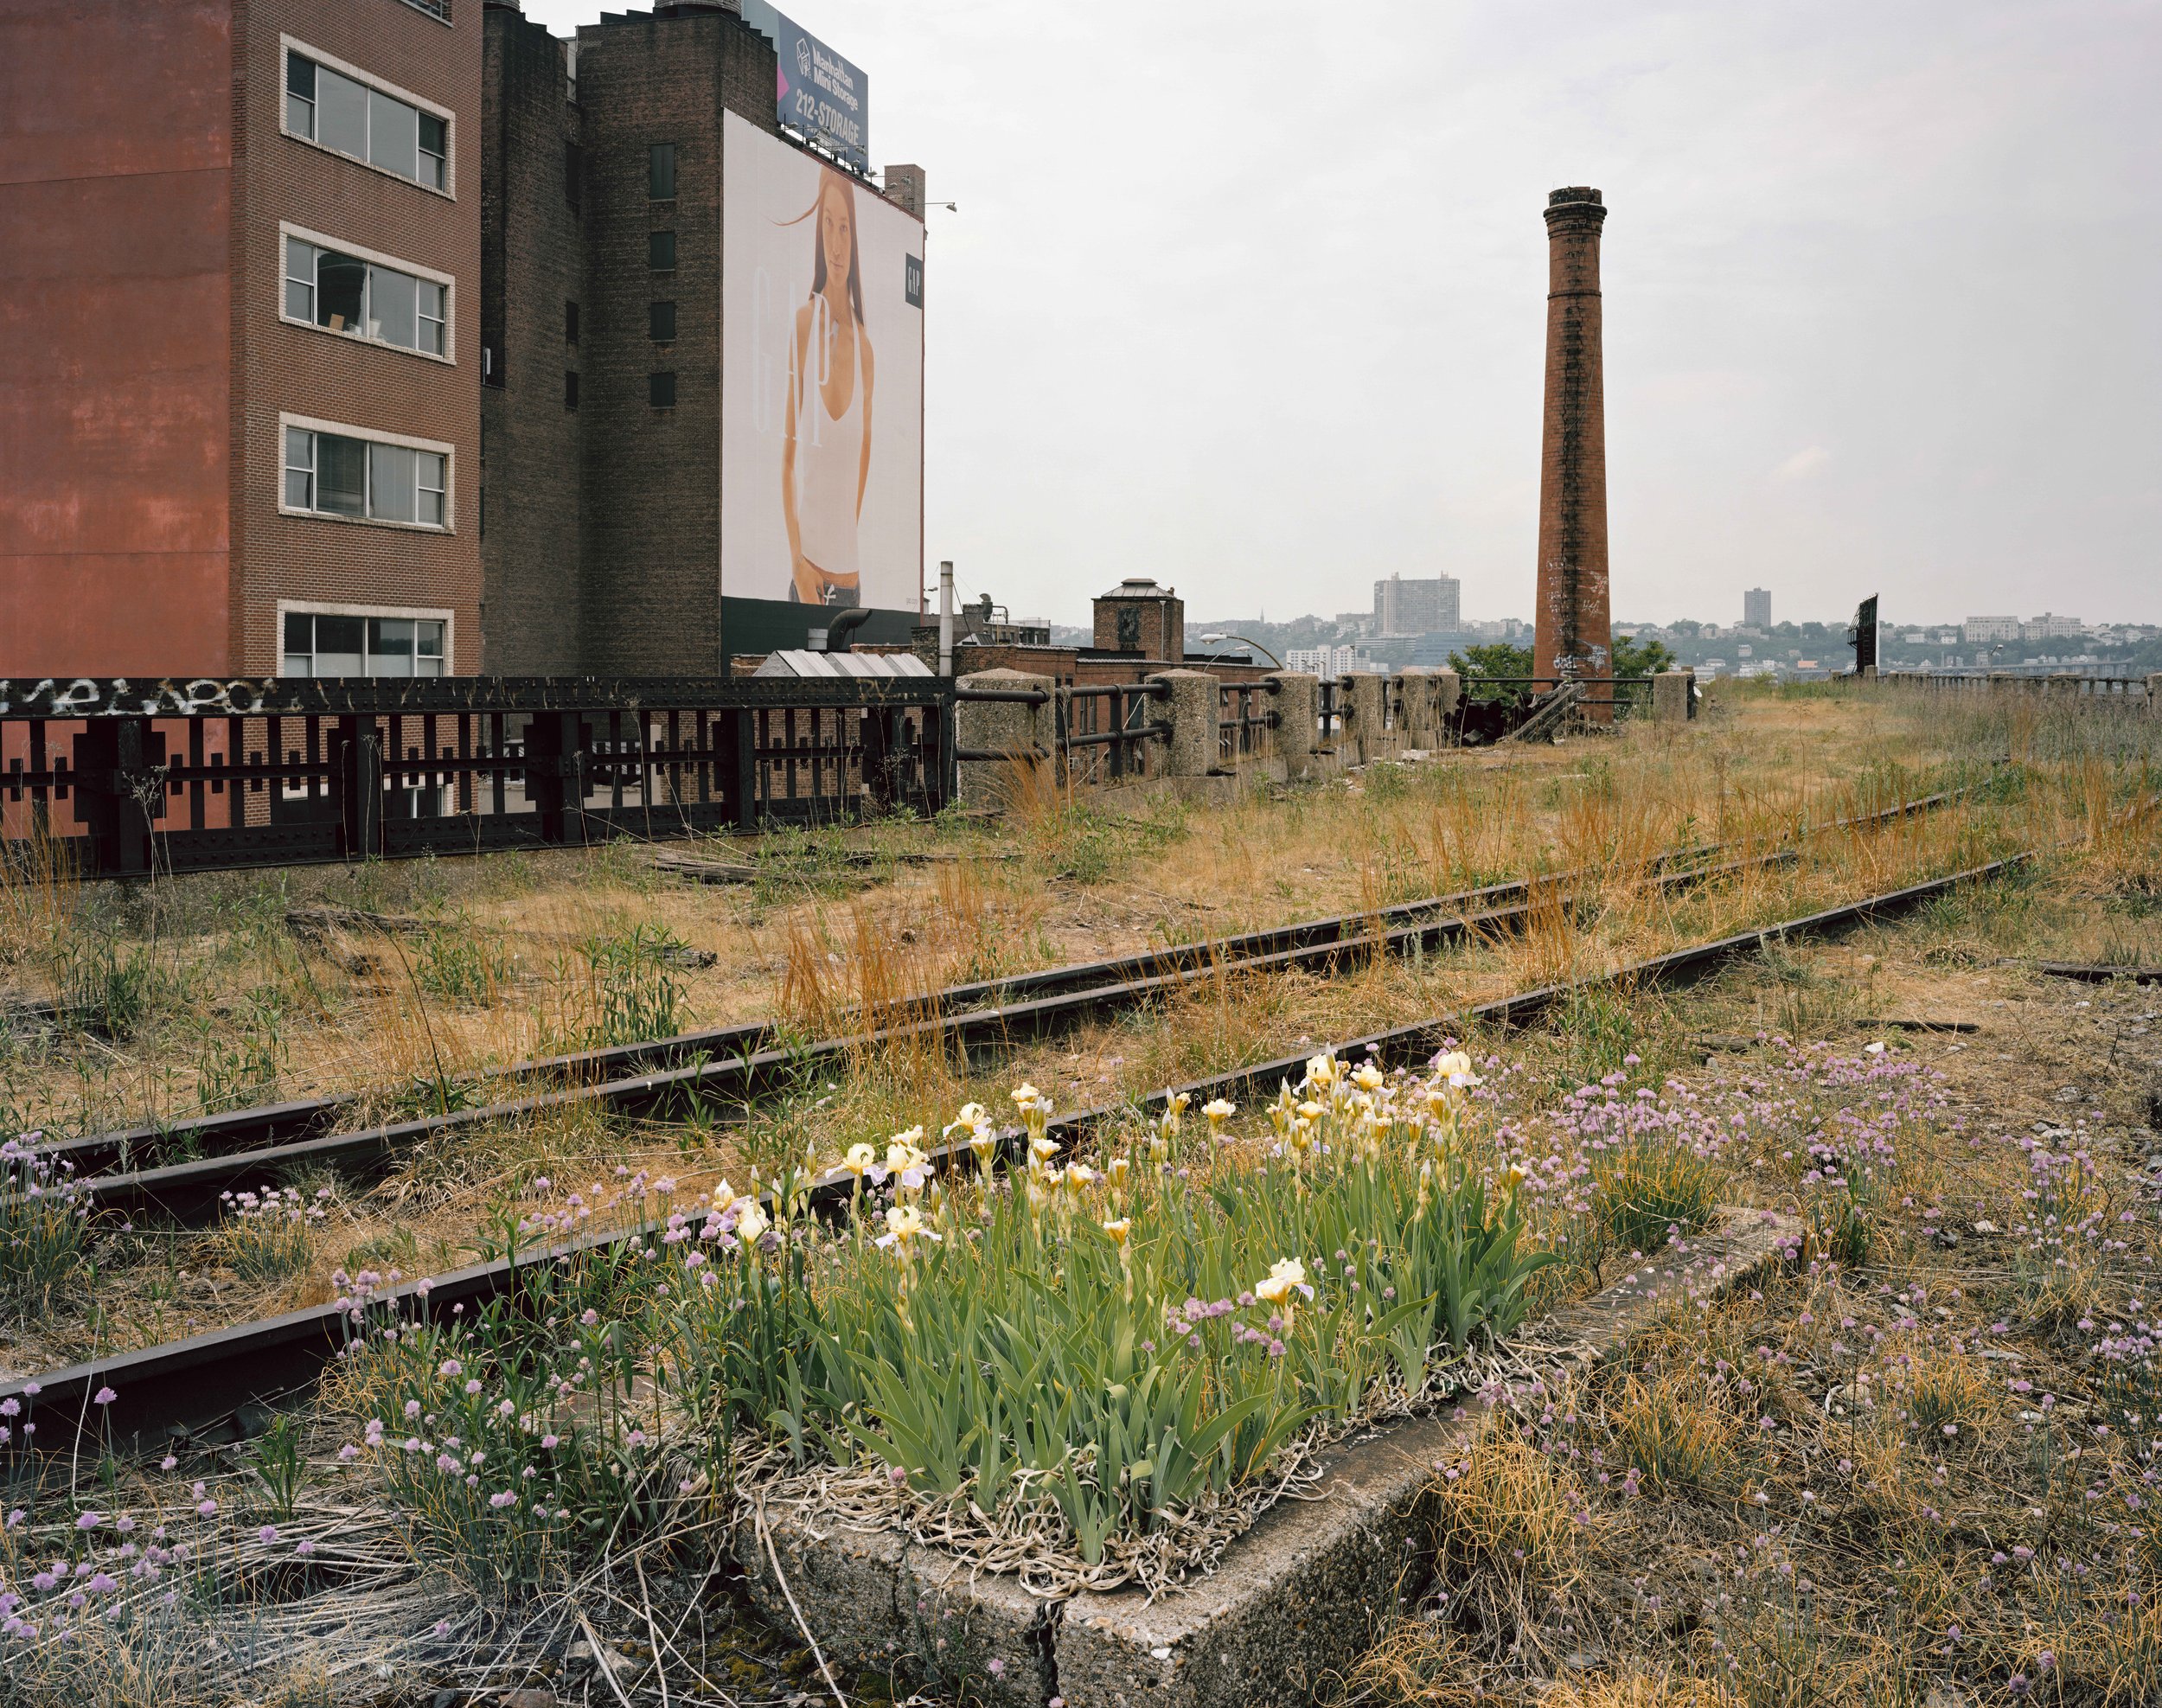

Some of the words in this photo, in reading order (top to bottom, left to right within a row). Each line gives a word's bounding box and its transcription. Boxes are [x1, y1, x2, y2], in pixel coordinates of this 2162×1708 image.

[813, 44, 854, 90] Manhattan
[814, 67, 832, 92] Mini
[832, 79, 858, 111] Storage
[796, 88, 859, 144] 212-STORAGE
[907, 265, 920, 297] GAP
